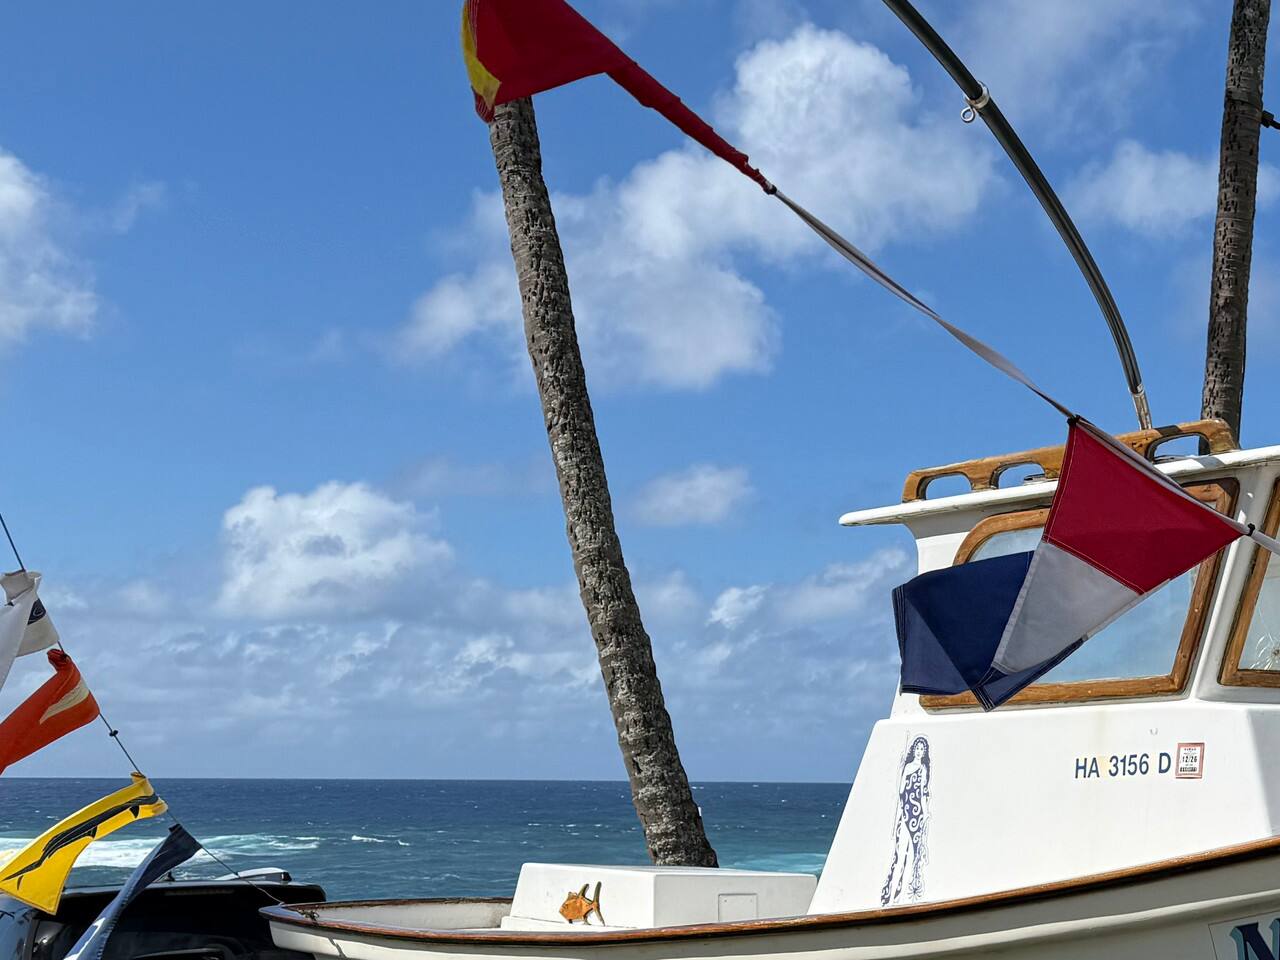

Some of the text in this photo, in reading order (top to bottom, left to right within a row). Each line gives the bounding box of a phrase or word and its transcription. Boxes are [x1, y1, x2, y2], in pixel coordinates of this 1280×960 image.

[1074, 752, 1171, 779] HA 3156 D
